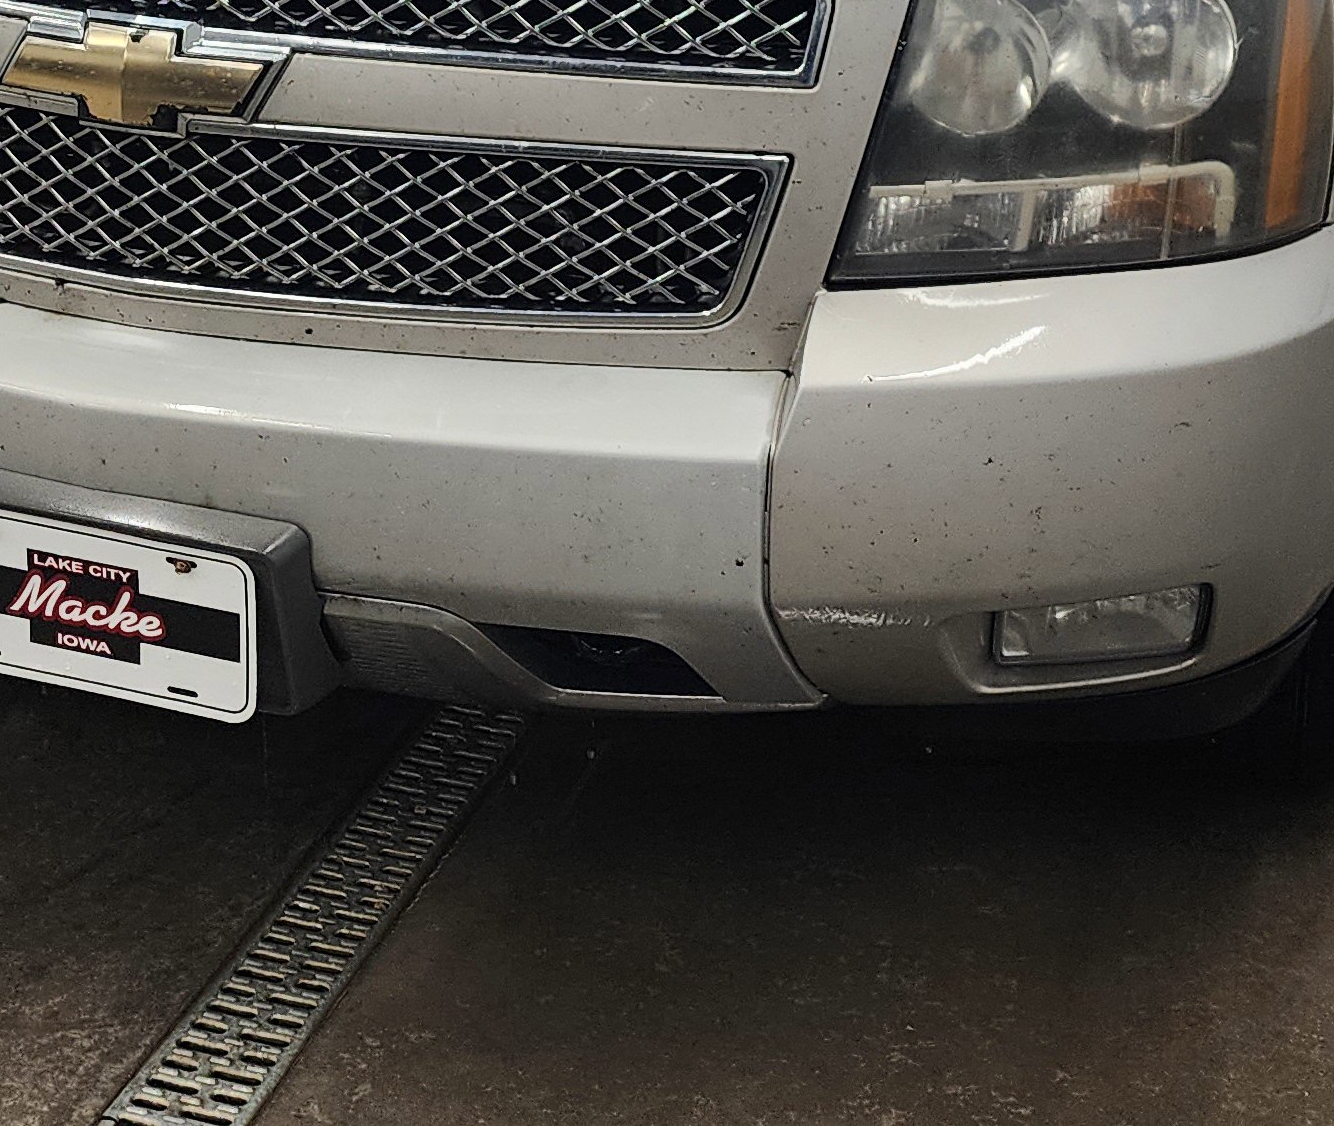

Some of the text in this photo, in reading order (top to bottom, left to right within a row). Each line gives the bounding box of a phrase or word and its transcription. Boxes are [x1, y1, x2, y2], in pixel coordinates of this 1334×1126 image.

[33, 553, 131, 583] LAKE CITY
[8, 572, 165, 640] Macke
[57, 632, 111, 655] IOWA
